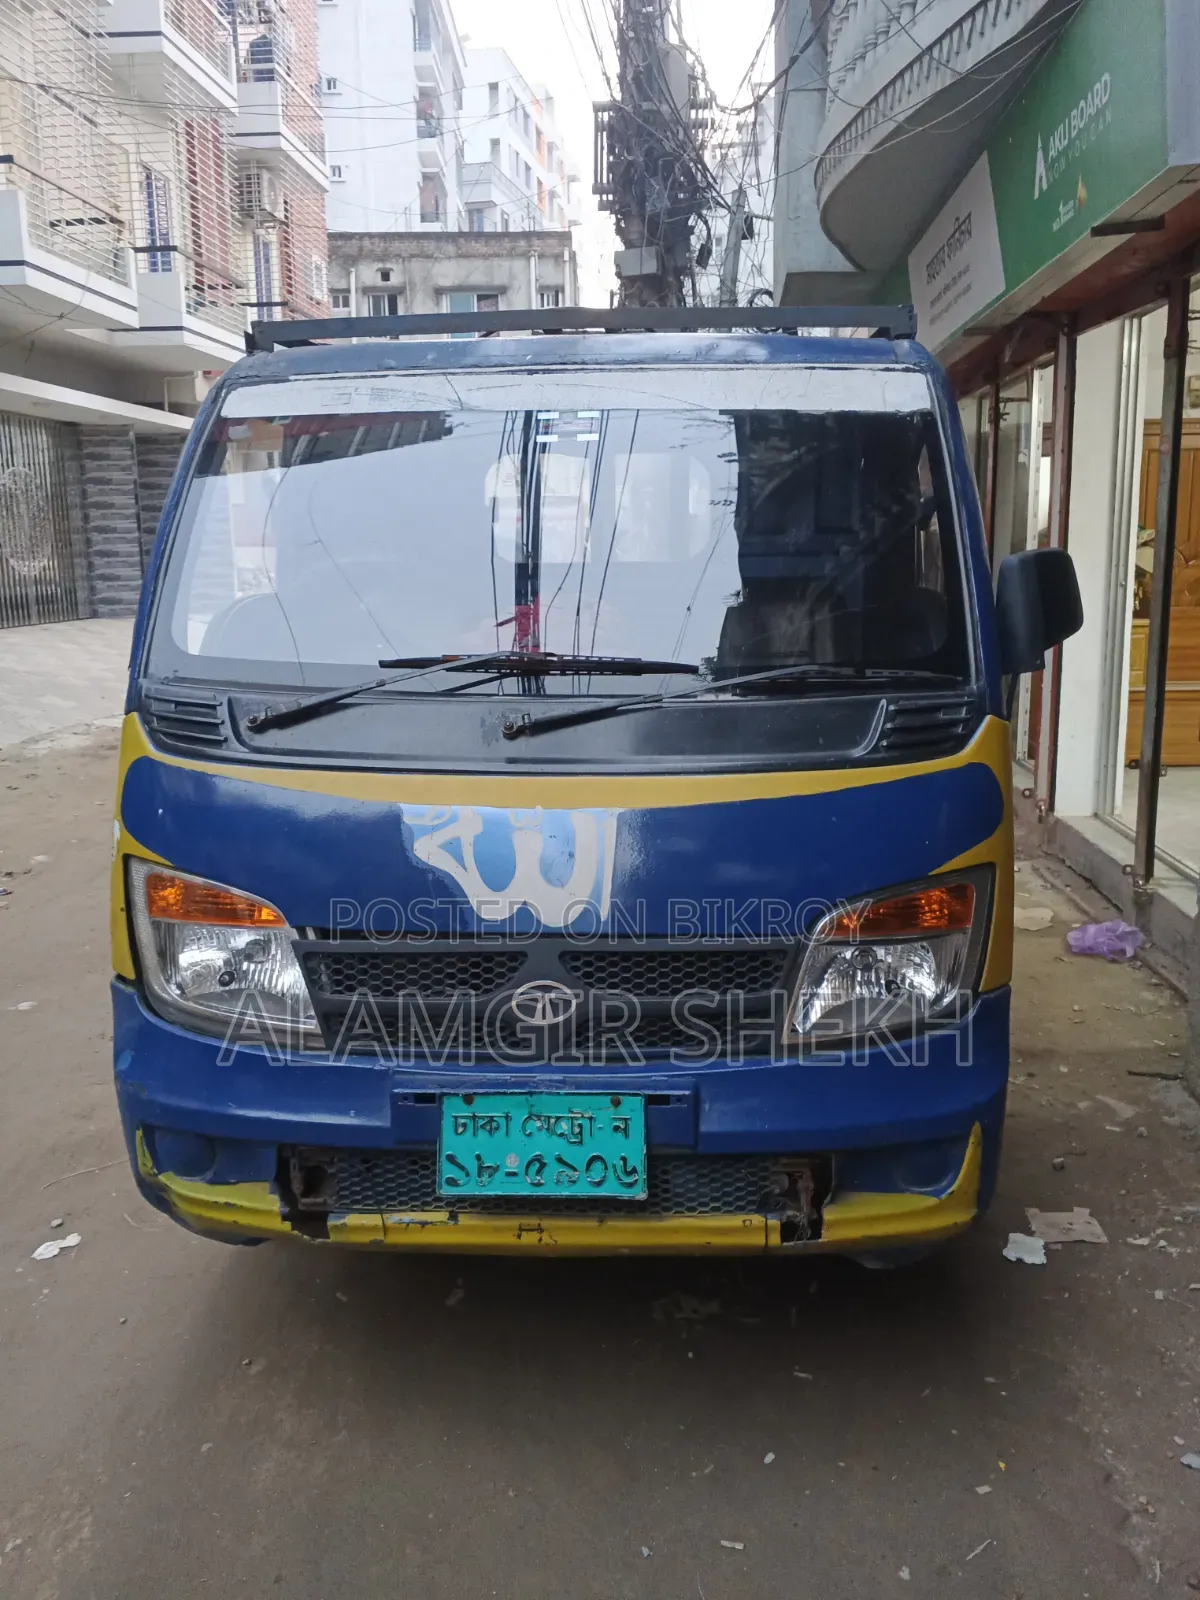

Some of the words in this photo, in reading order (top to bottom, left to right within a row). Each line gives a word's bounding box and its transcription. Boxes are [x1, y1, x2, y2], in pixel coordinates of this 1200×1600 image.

[1048, 116, 1069, 163] AKU
[1070, 72, 1111, 138] BOARD
[1068, 131, 1087, 163] YOU
[1090, 107, 1112, 141] CAN
[451, 1112, 512, 1138] ঢাকা
